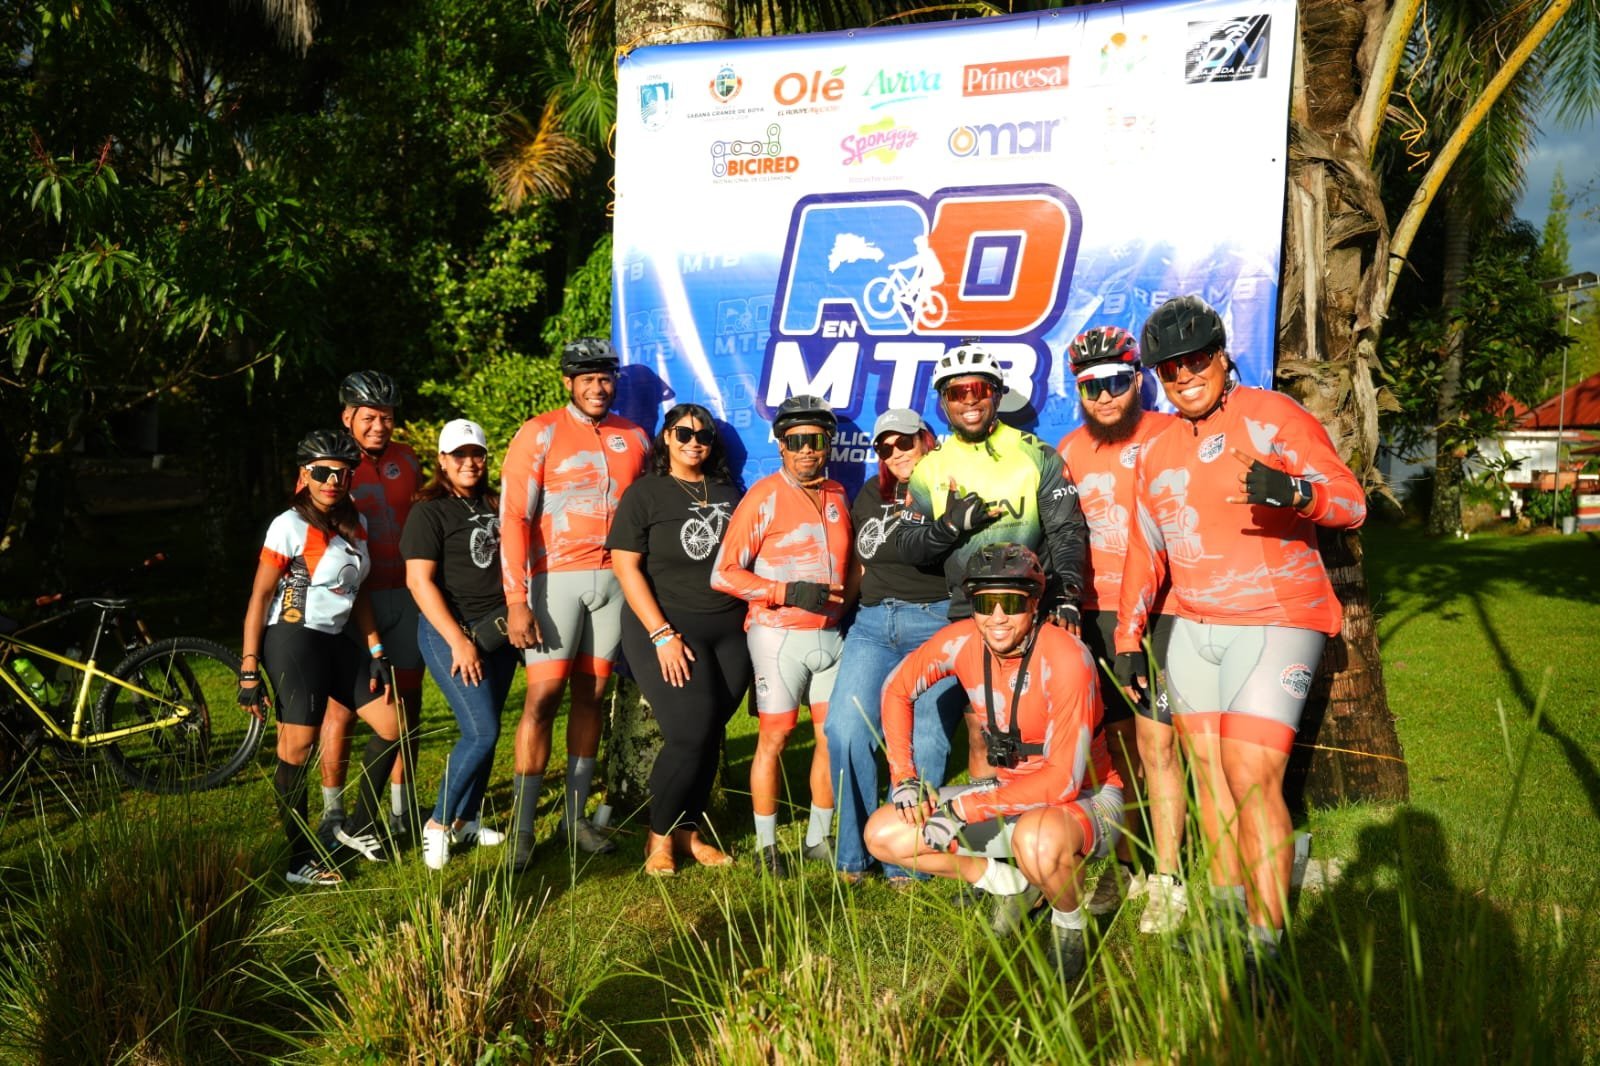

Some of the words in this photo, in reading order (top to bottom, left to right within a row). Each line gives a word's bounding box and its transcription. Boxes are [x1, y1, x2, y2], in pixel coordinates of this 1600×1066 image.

[773, 65, 847, 106] Olé
[862, 68, 943, 97] Aviva
[966, 65, 1063, 93] Princesa
[840, 128, 919, 166] Sponggy
[948, 118, 1062, 158] omar
[727, 155, 800, 176] BICIRED
[822, 319, 858, 339] EN
